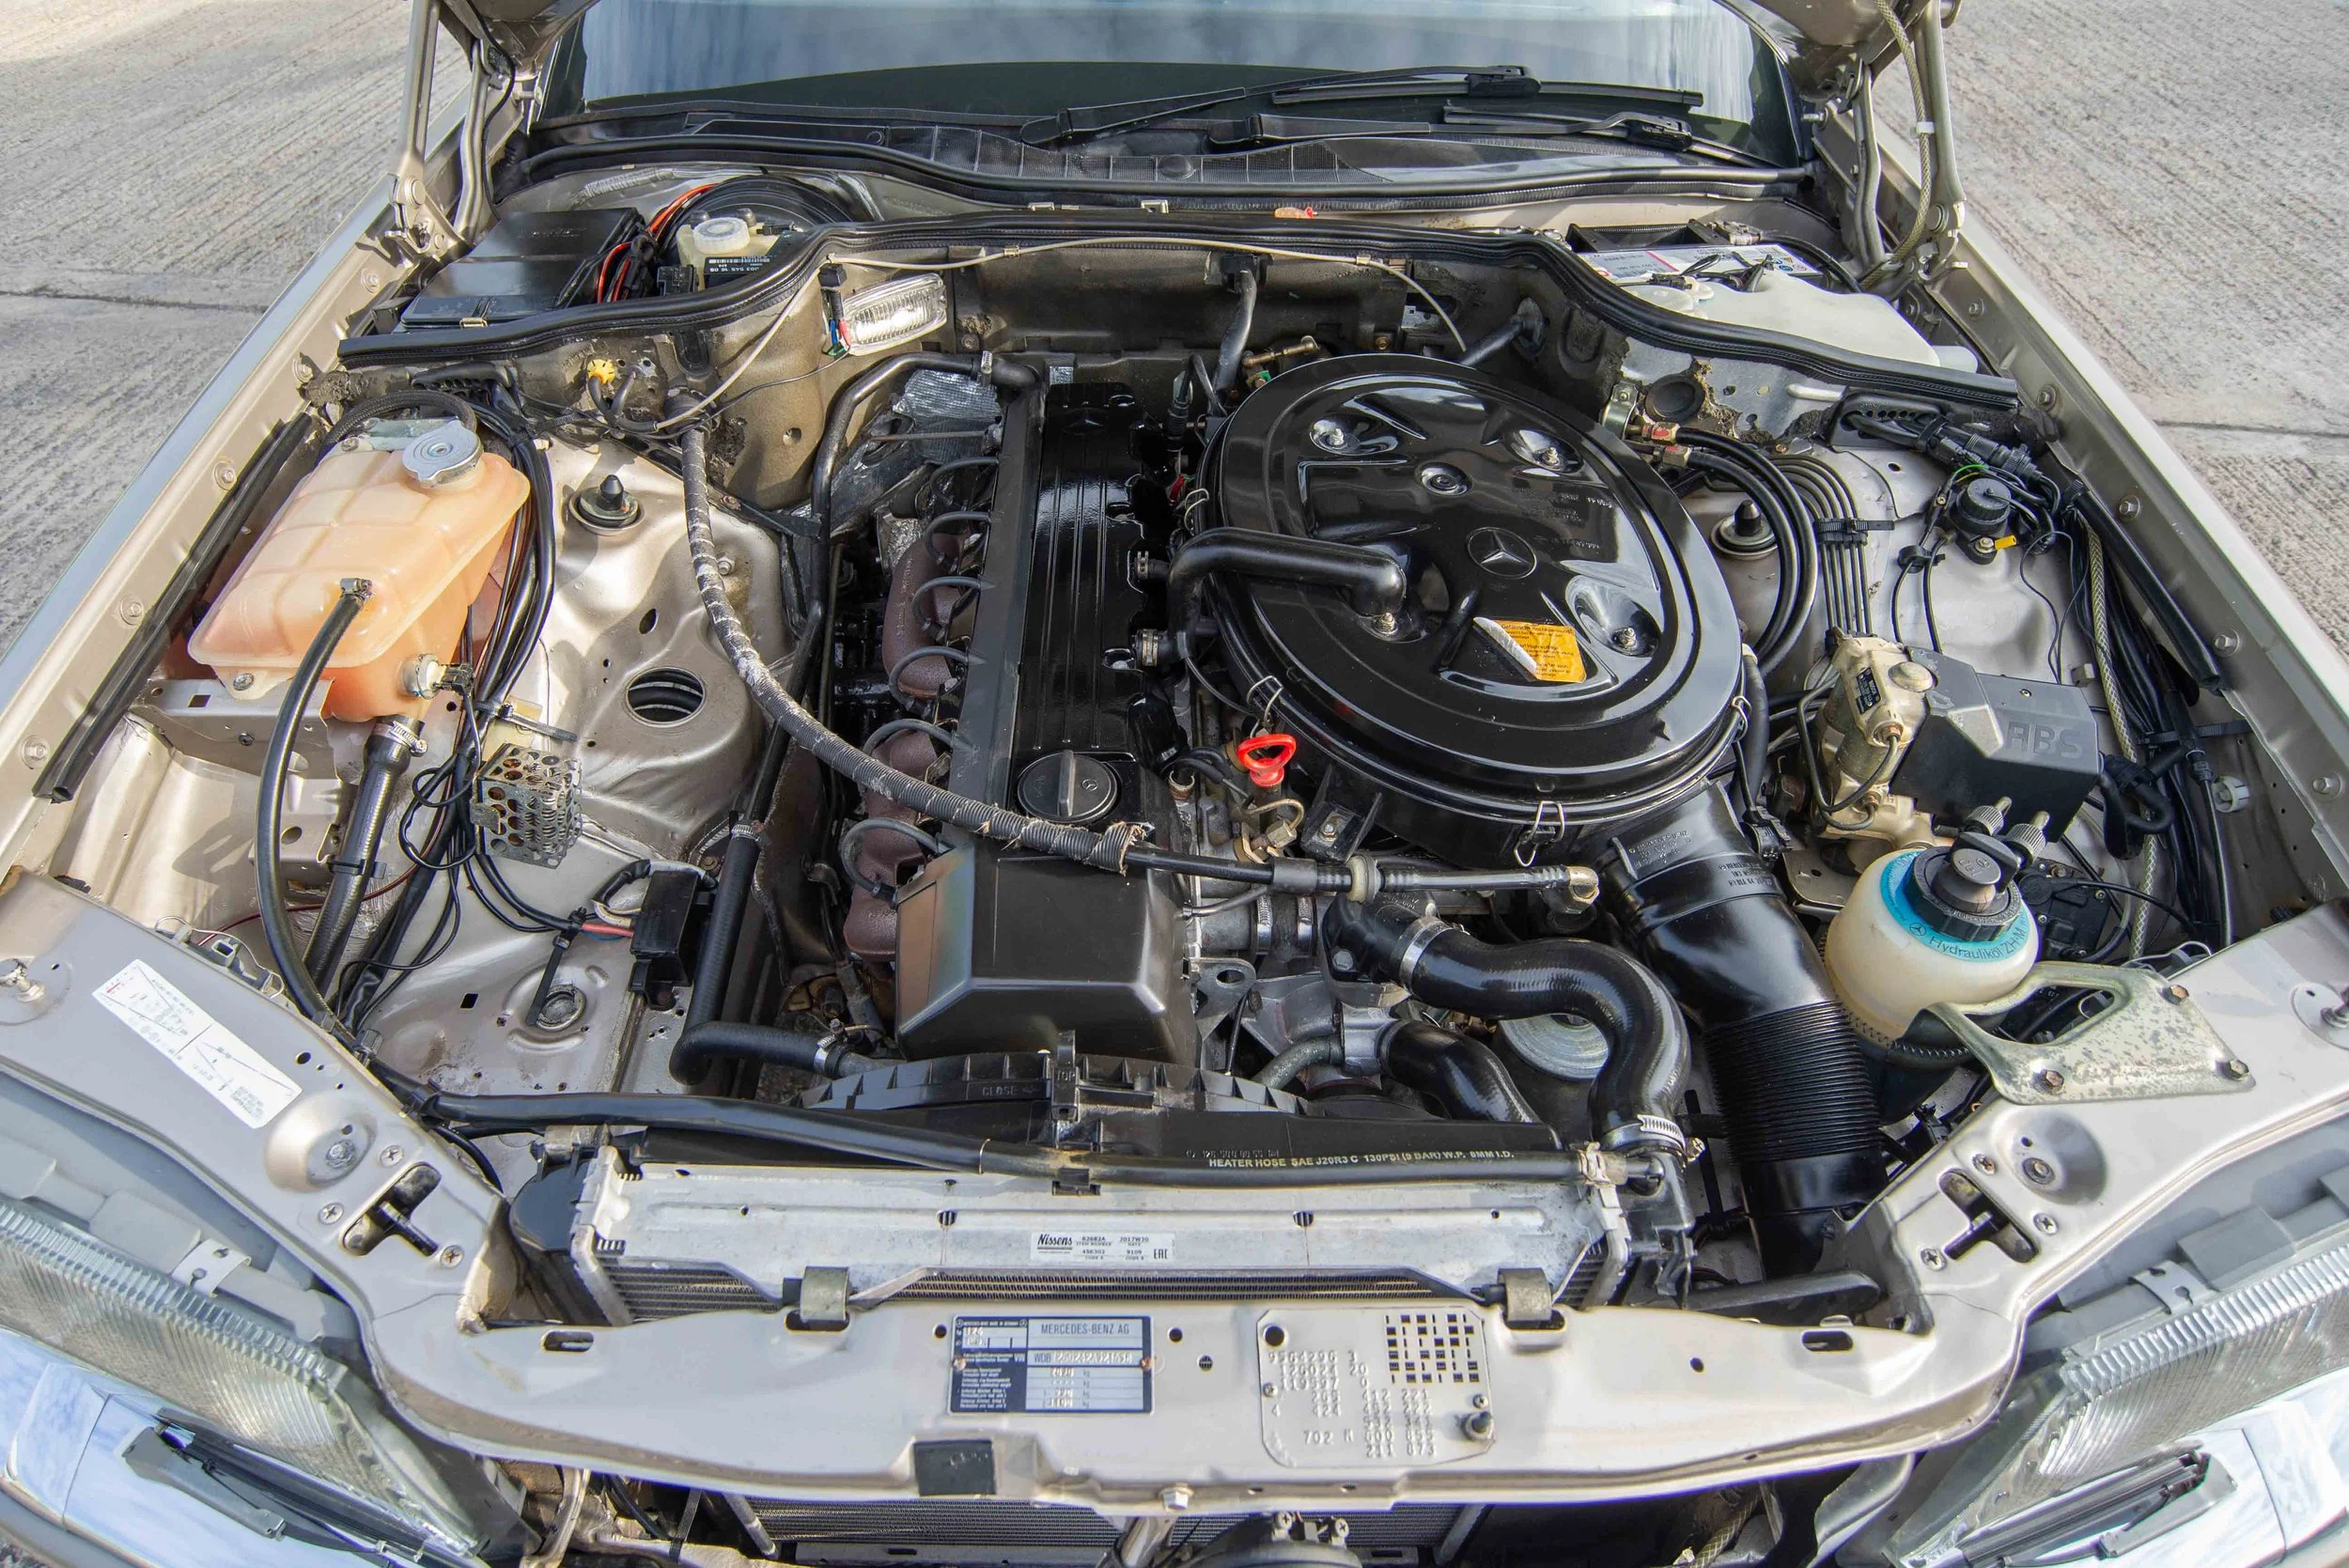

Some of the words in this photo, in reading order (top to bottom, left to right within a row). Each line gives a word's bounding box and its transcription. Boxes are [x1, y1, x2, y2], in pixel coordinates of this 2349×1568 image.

[2006, 722, 2083, 759] ABS
[1929, 936, 2004, 959] Hydrauliköl
[1208, 1158, 1252, 1168] HEATER
[1255, 1158, 1286, 1167] HOSE
[1291, 1157, 1314, 1166] SAE
[1315, 1156, 1348, 1165] J20R3
[1350, 1155, 1359, 1163] C
[1363, 1154, 1400, 1162] 130PSI
[1037, 1234, 1072, 1246] Nissens
[1040, 1323, 1114, 1334] MERCEDES-BENZ
[1117, 1323, 1129, 1334] AG
[1034, 1353, 1051, 1362] WDB
[1303, 1430, 1334, 1445] 702
